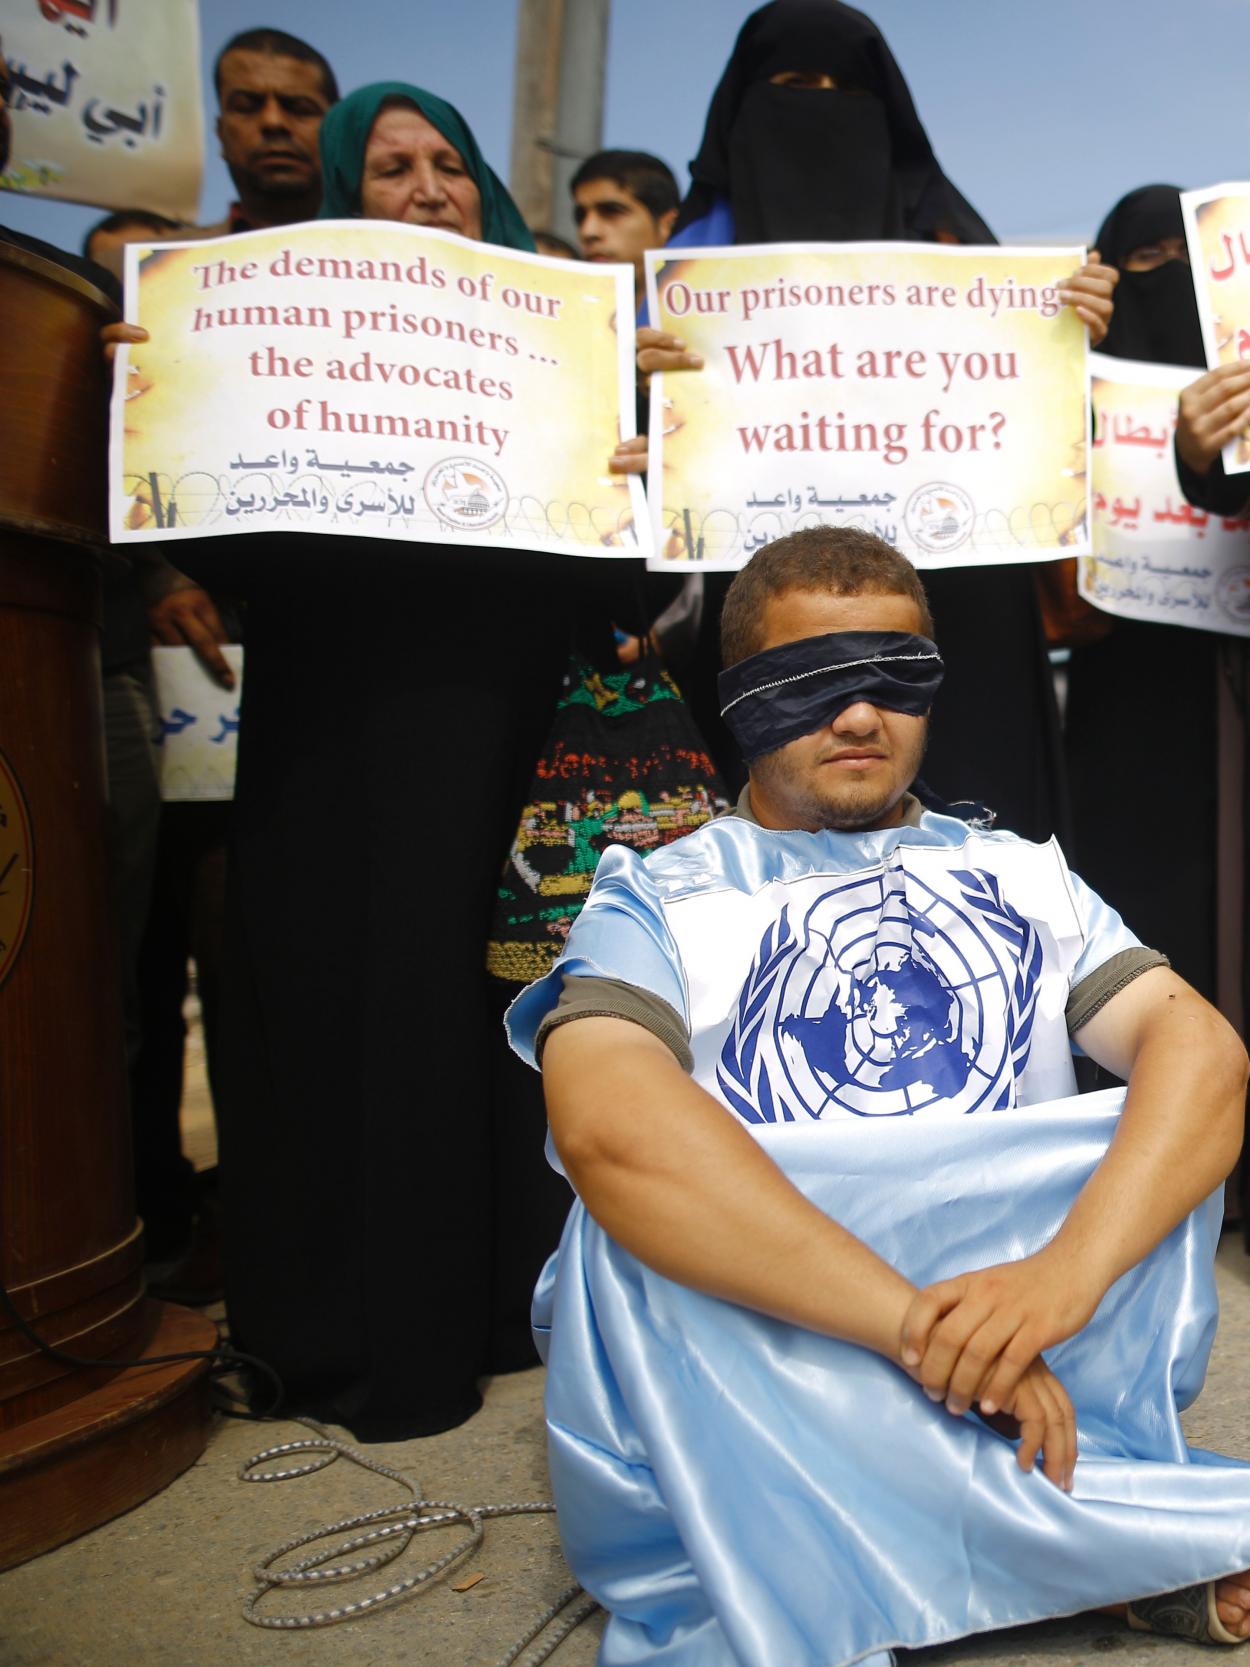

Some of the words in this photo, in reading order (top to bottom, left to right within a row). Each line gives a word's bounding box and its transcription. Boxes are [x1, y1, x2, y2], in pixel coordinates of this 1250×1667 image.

[82, 84, 165, 148] أبي
[193, 258, 258, 290] The
[269, 250, 446, 289] demands
[457, 274, 493, 301] of
[501, 287, 561, 318] our
[665, 283, 731, 316] Our
[740, 279, 896, 320] prisoners
[907, 285, 956, 308] are
[191, 305, 332, 332] human
[249, 347, 314, 378] the
[326, 352, 514, 400] advocates
[724, 340, 844, 385] What
[856, 348, 927, 380] are
[937, 350, 1019, 393] you
[267, 399, 312, 430] of
[320, 400, 510, 456] humanity
[737, 411, 908, 465] waiting
[920, 410, 1007, 453] for?
[229, 449, 299, 475] واعد
[306, 449, 415, 482] جمعية
[225, 488, 328, 516] والمحررين
[335, 488, 415, 516] للأسرى
[746, 488, 801, 512] واعد
[807, 486, 897, 512] جمعية
